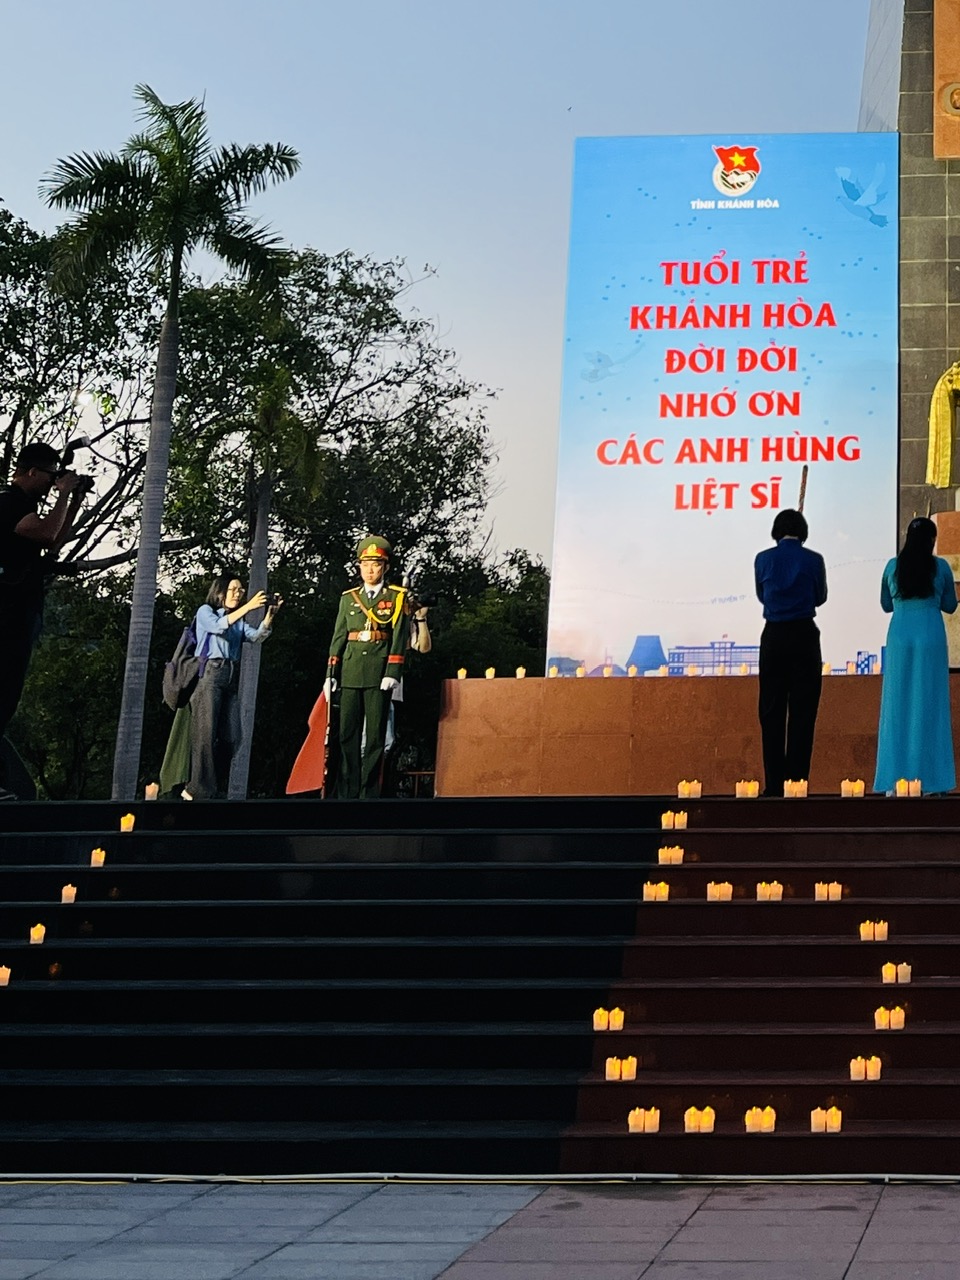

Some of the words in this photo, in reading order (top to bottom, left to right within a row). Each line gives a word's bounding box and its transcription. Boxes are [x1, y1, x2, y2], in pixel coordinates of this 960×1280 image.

[690, 198, 715, 210] TỈNH
[717, 198, 755, 209] KHÁNH
[757, 197, 780, 209] HÒA
[660, 250, 740, 286] TUỔI
[752, 251, 810, 285] TRẺ
[628, 298, 751, 331] KHÁNH
[763, 296, 837, 329] HÒA
[664, 342, 725, 374] ĐỜI
[737, 340, 798, 373] ĐỜI
[659, 387, 736, 418] NHỚ
[747, 390, 801, 417] ƠN
[596, 433, 665, 465] CÁC
[674, 437, 749, 465] ANH
[761, 431, 861, 463] HÙNG
[674, 478, 740, 515] LIỆT
[750, 477, 782, 509] SĨ
